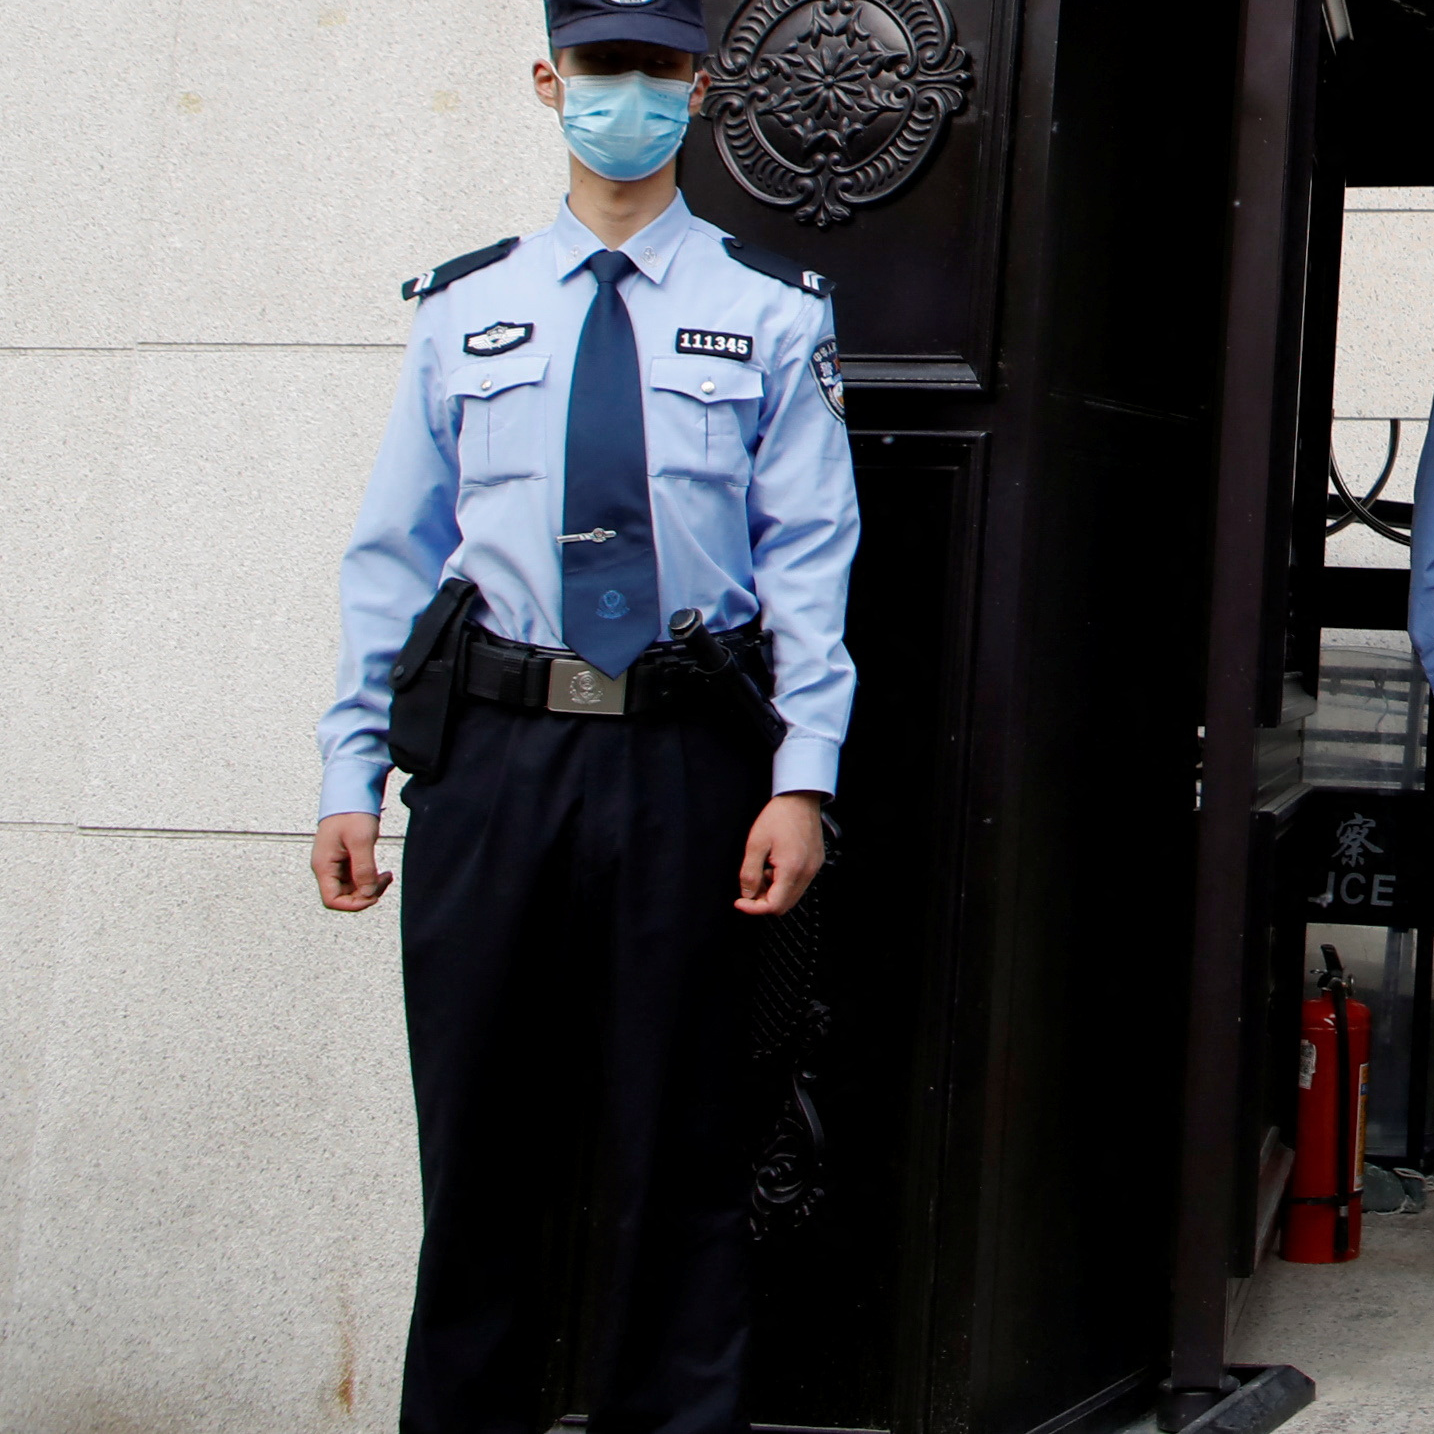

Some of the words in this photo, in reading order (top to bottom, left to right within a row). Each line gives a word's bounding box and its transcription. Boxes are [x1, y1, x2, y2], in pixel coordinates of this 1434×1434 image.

[680, 332, 749, 355] 111345
[1331, 812, 1384, 867] 察
[1325, 871, 1396, 907] ICE
